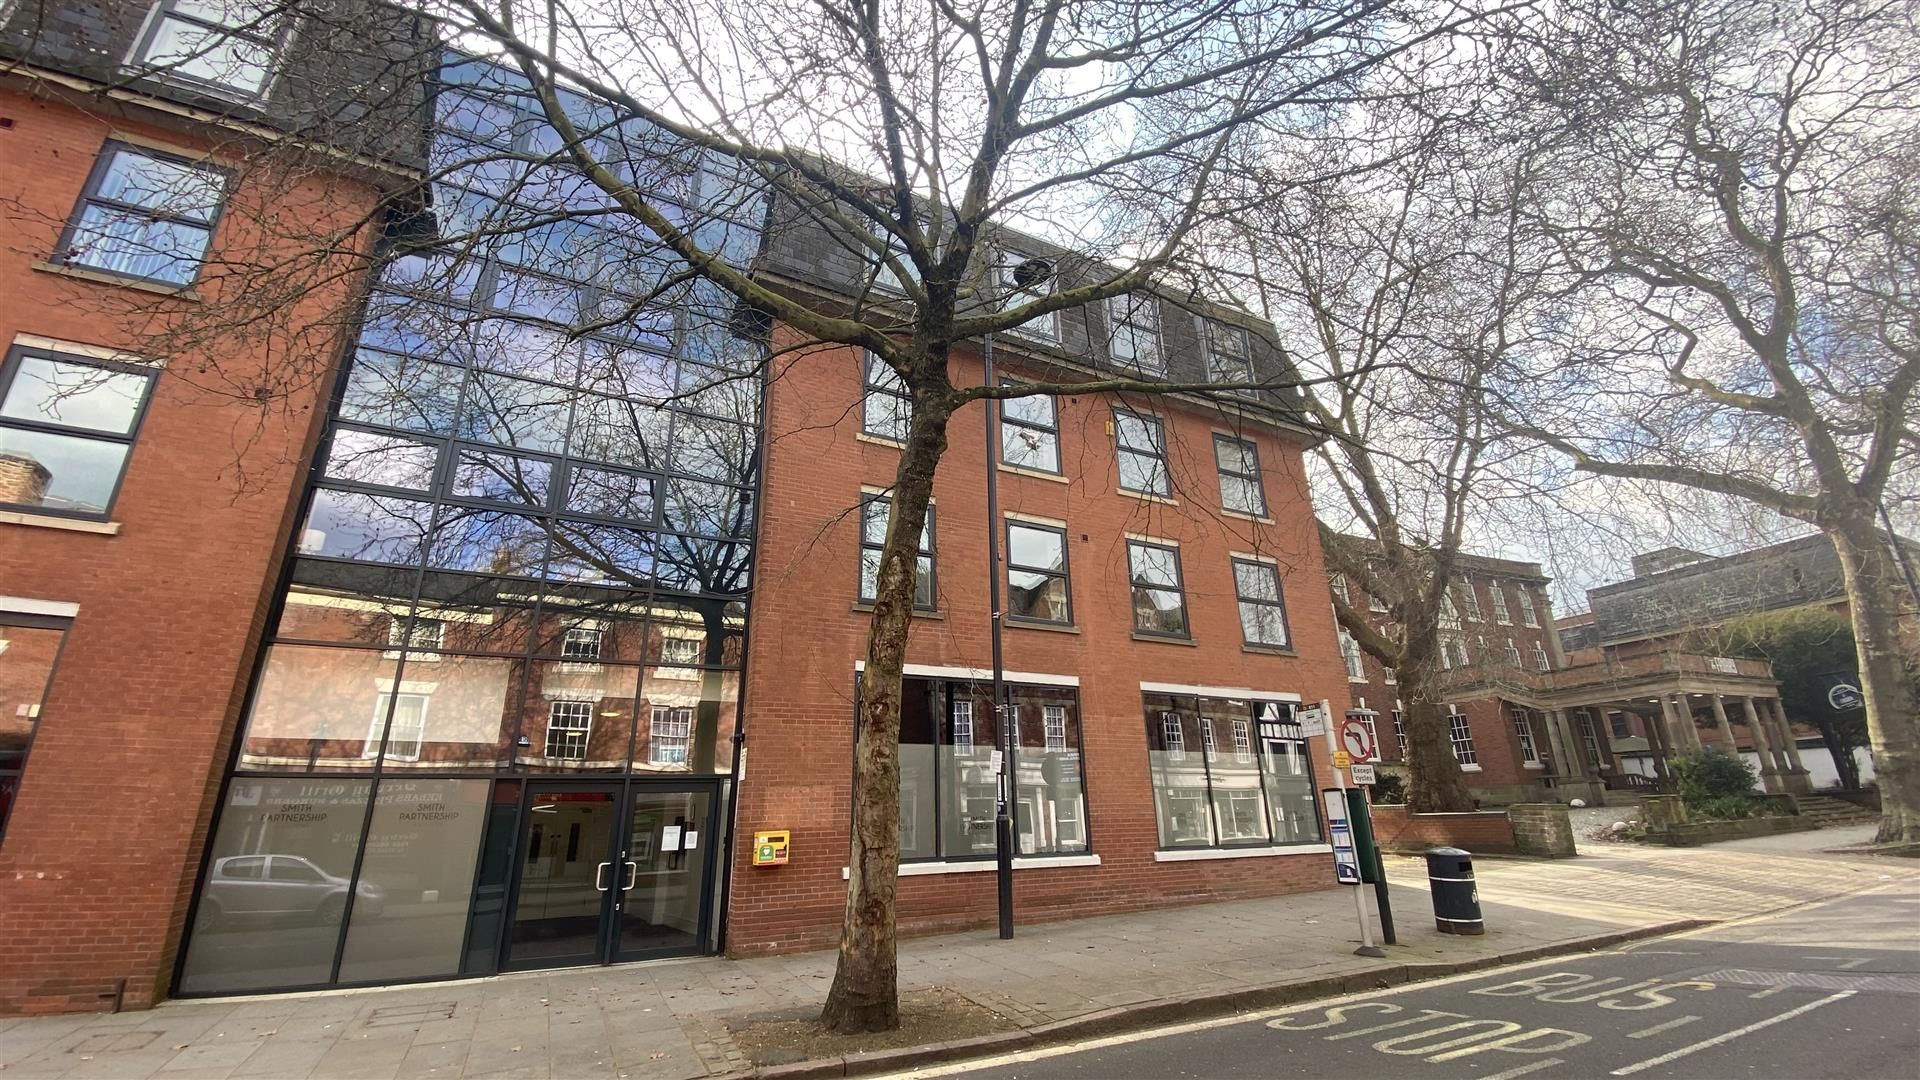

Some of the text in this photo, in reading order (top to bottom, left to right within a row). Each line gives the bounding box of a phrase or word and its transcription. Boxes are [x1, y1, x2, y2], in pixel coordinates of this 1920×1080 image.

[1353, 767, 1372, 775] Except
[1355, 775, 1373, 783] cycles
[281, 803, 312, 813] SMITH
[417, 803, 445, 812] SMITH
[261, 813, 327, 822] PARTNERSHIP
[399, 812, 459, 821] PARTNERSHIP
[1468, 972, 1716, 1012] BUS
[1266, 1003, 1593, 1063] STOP
